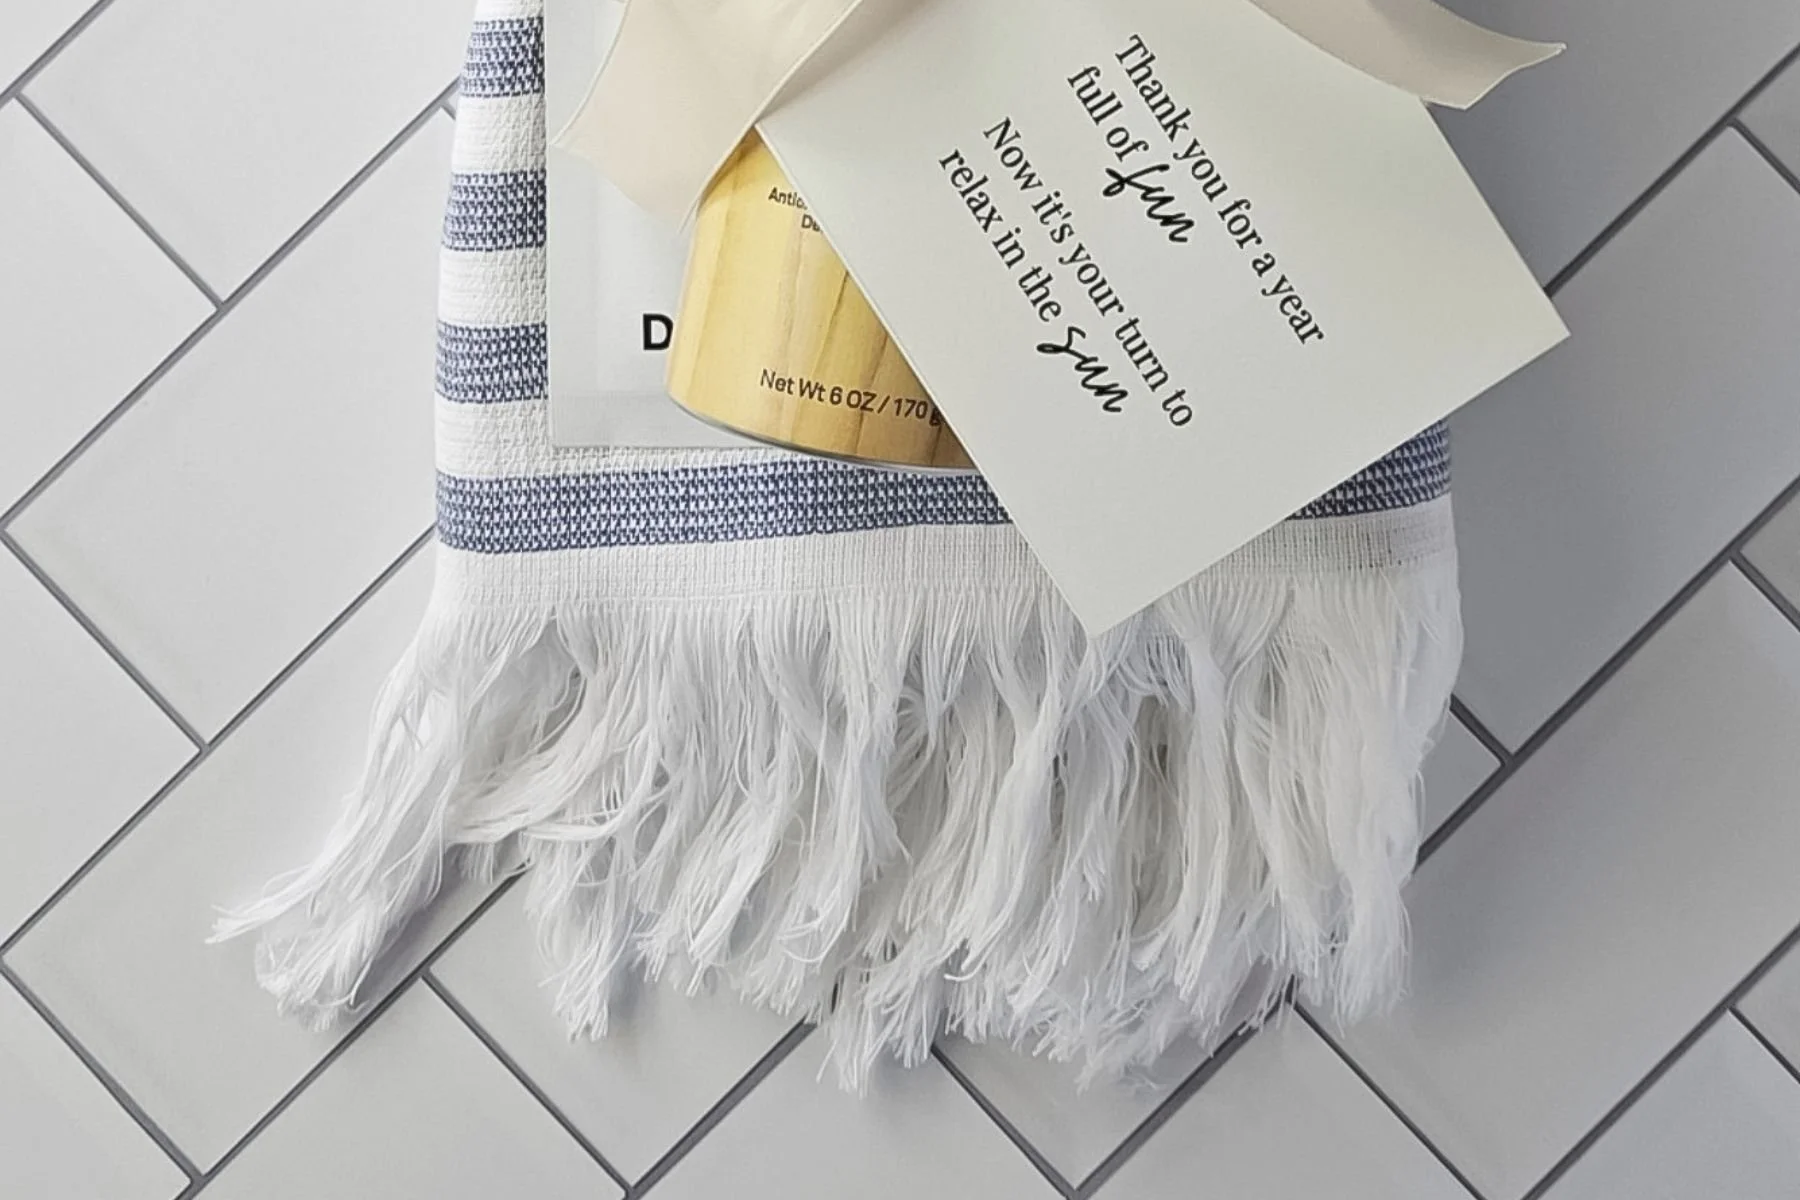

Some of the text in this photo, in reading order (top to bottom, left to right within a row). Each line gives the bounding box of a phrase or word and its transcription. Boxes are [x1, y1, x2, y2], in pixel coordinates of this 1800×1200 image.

[939, 148, 1129, 413] relax in the sun
[983, 116, 1193, 427] Now it's your turn to
[1067, 65, 1196, 244] full of fun
[1114, 33, 1325, 345] Thank you for a year
[760, 369, 795, 395] Net
[799, 378, 826, 402] Wt
[829, 386, 843, 405] 6
[846, 390, 877, 412] OZ
[877, 395, 890, 414] /
[894, 398, 928, 420] 170
